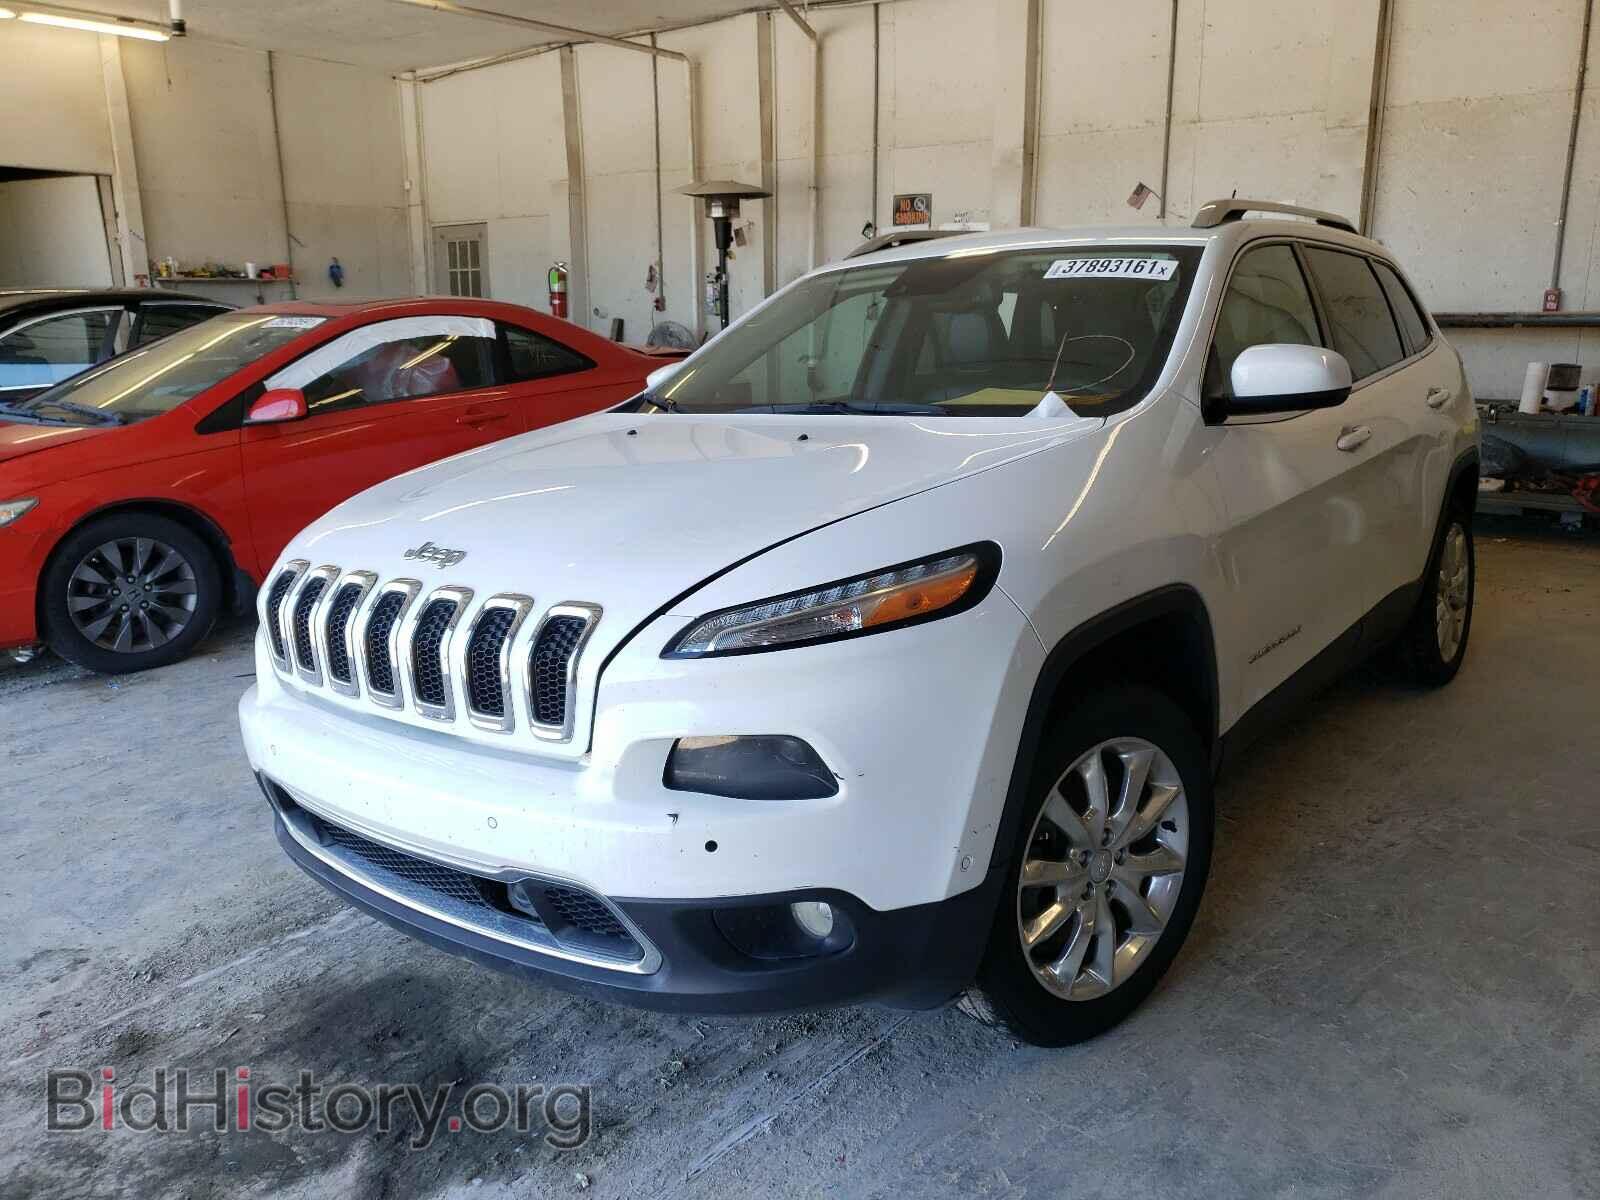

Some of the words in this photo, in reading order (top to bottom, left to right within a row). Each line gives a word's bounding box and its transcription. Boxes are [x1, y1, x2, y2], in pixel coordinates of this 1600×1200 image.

[900, 199, 911, 211] NO
[895, 211, 929, 225] SMOKING
[404, 541, 466, 569] Jeep
